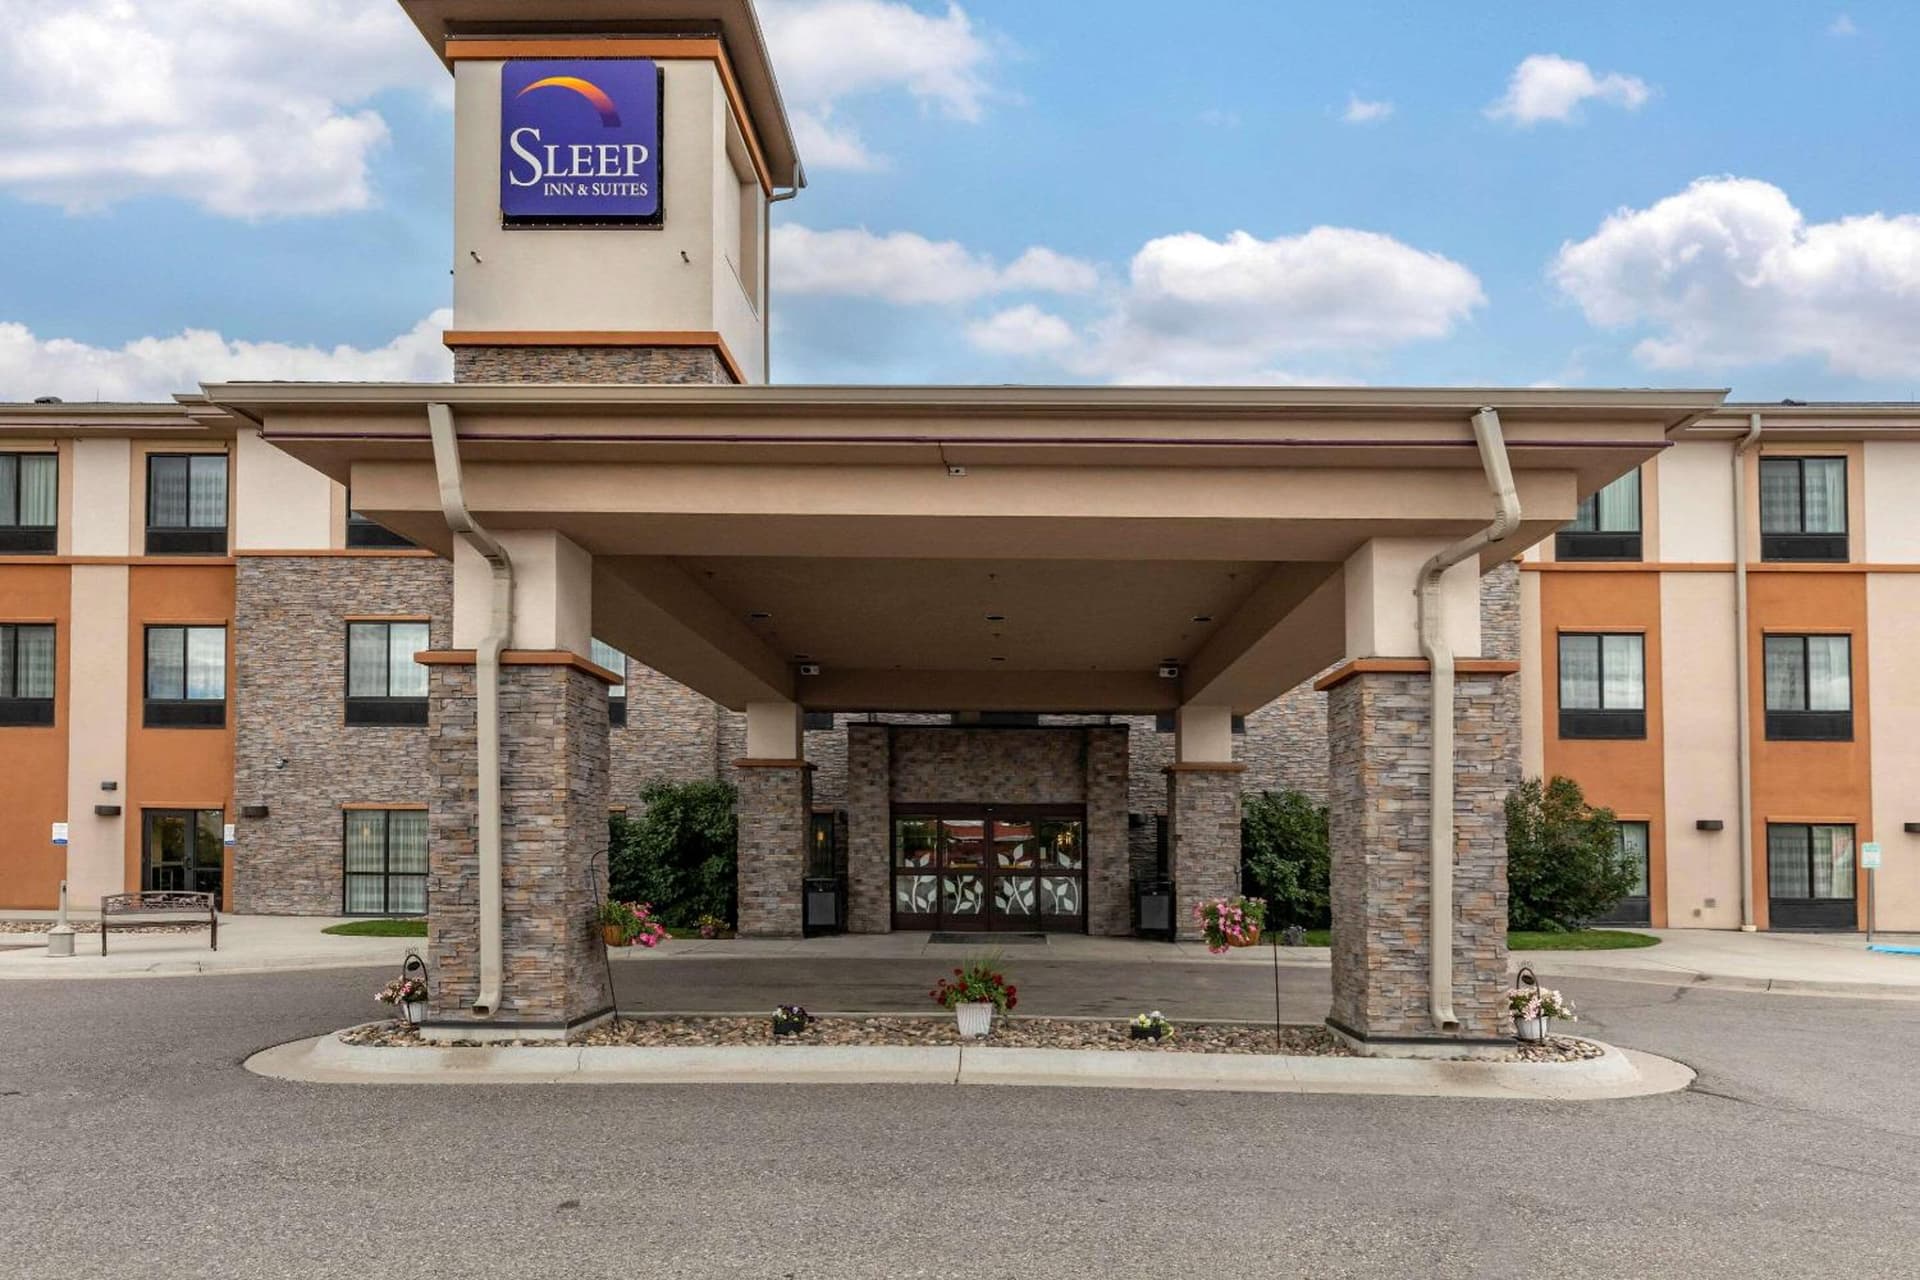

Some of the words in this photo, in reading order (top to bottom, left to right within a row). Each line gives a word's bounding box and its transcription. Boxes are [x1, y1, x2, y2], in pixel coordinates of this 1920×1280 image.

[509, 127, 649, 187] SLEEP
[544, 183, 575, 196] INN
[577, 183, 589, 196] &
[592, 183, 648, 196] SUITES
